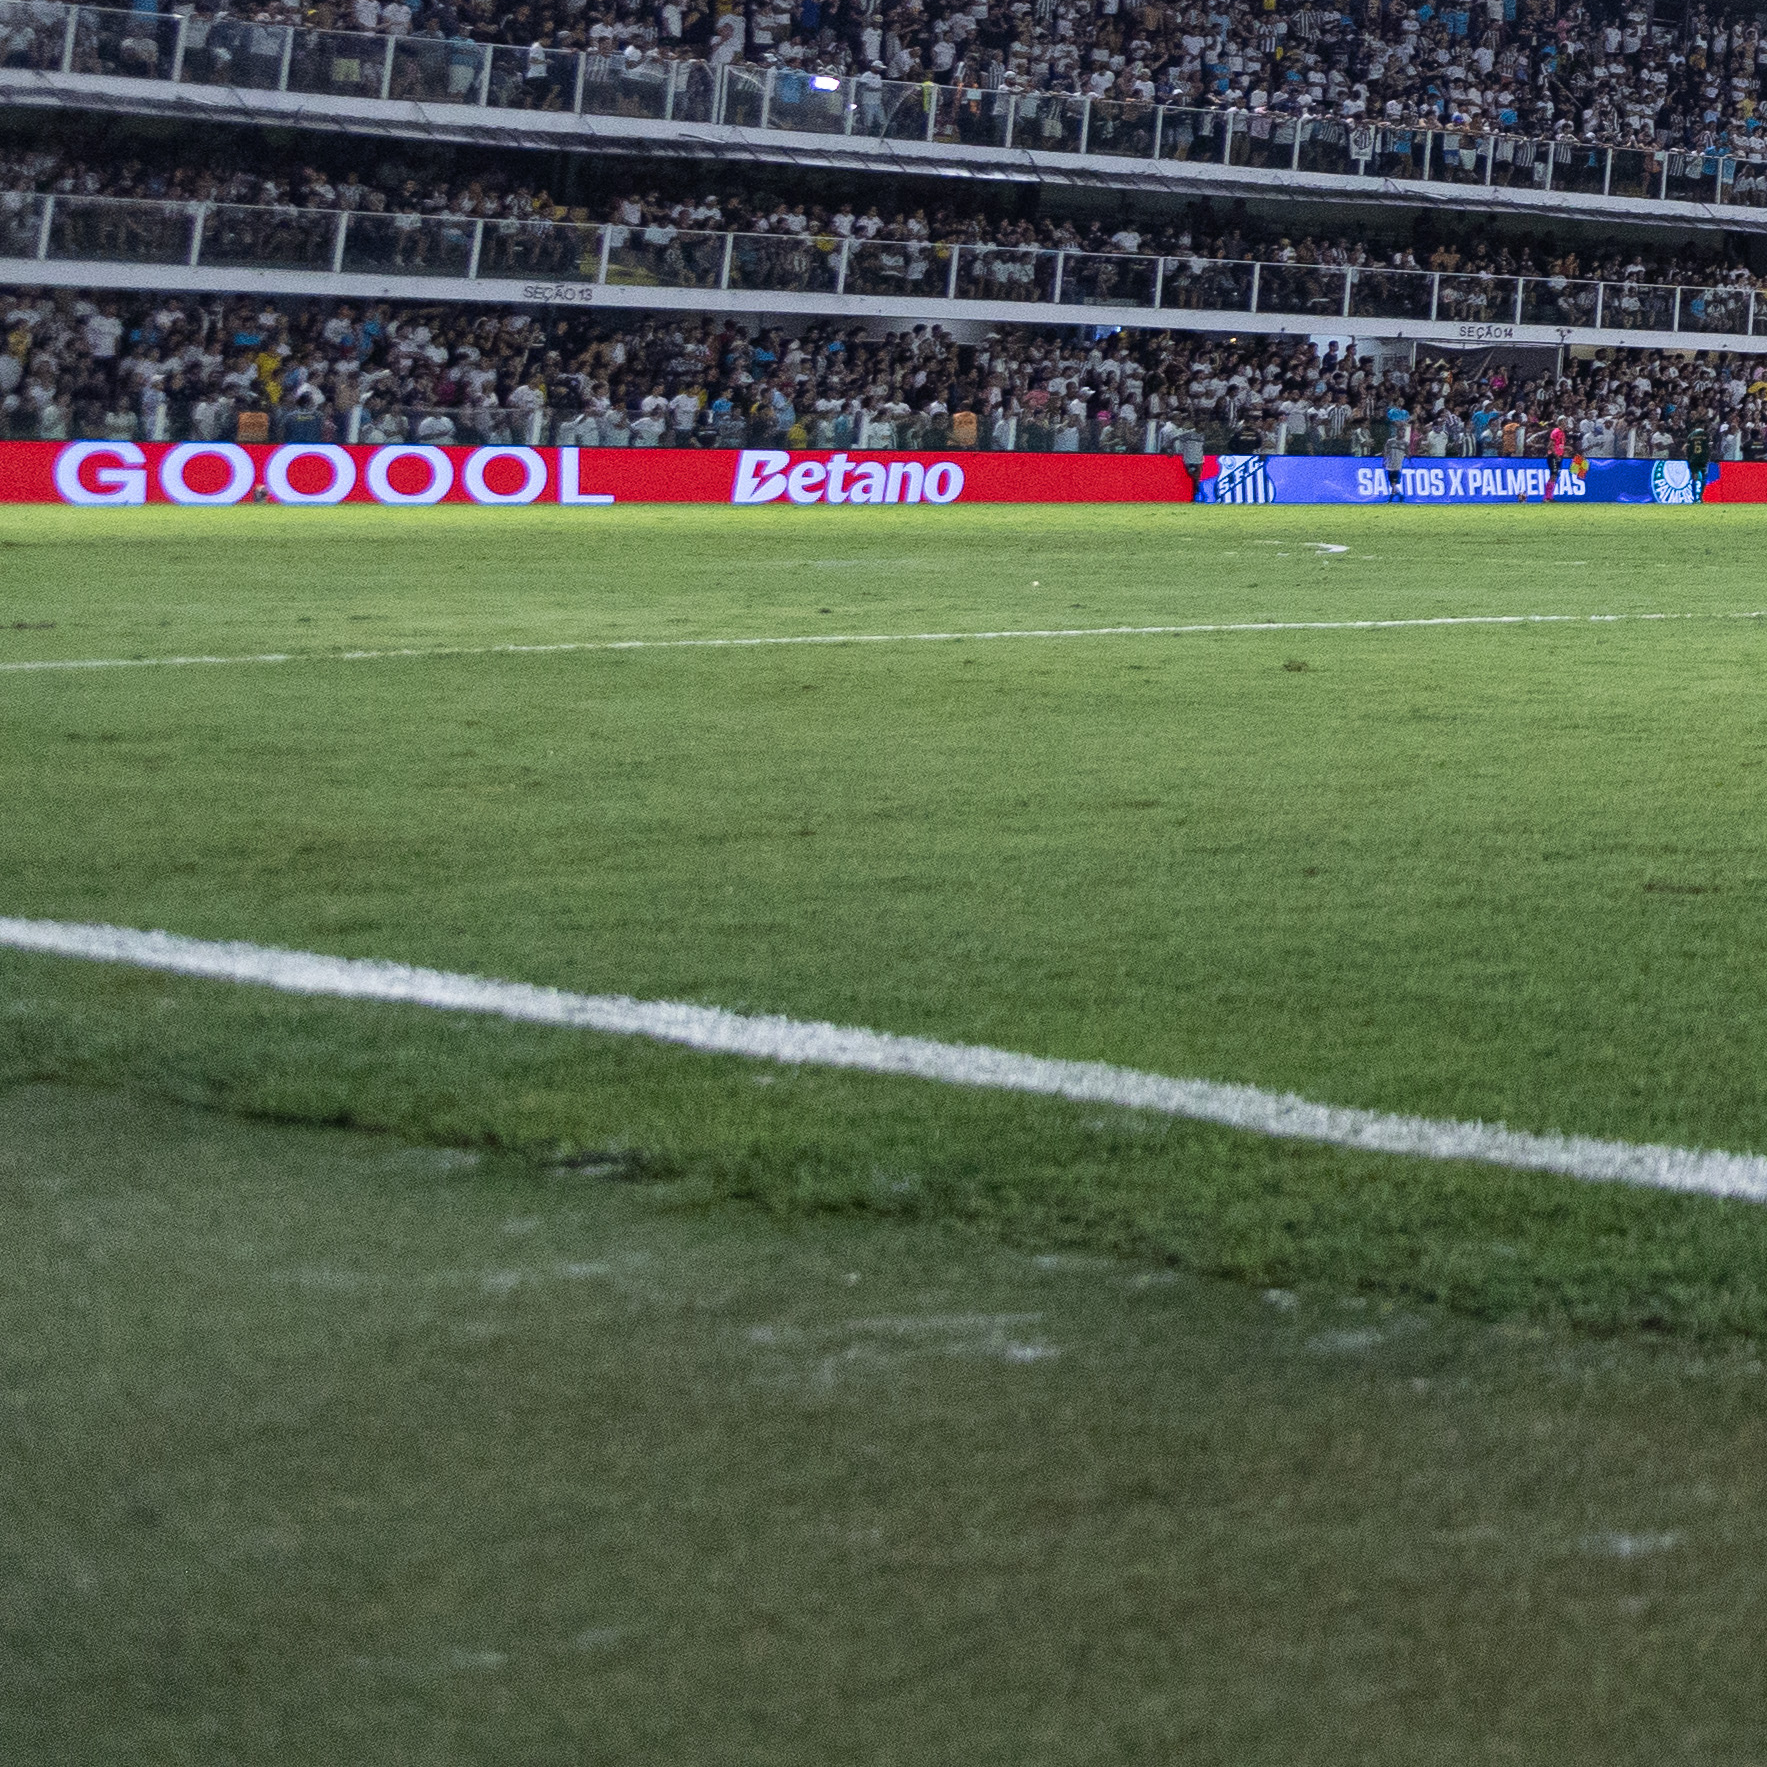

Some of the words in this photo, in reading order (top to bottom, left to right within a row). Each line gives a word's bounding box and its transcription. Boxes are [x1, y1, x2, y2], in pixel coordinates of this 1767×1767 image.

[53, 439, 616, 506] GOOOOL
[732, 449, 966, 504] Betano
[1448, 468, 1465, 496] X
